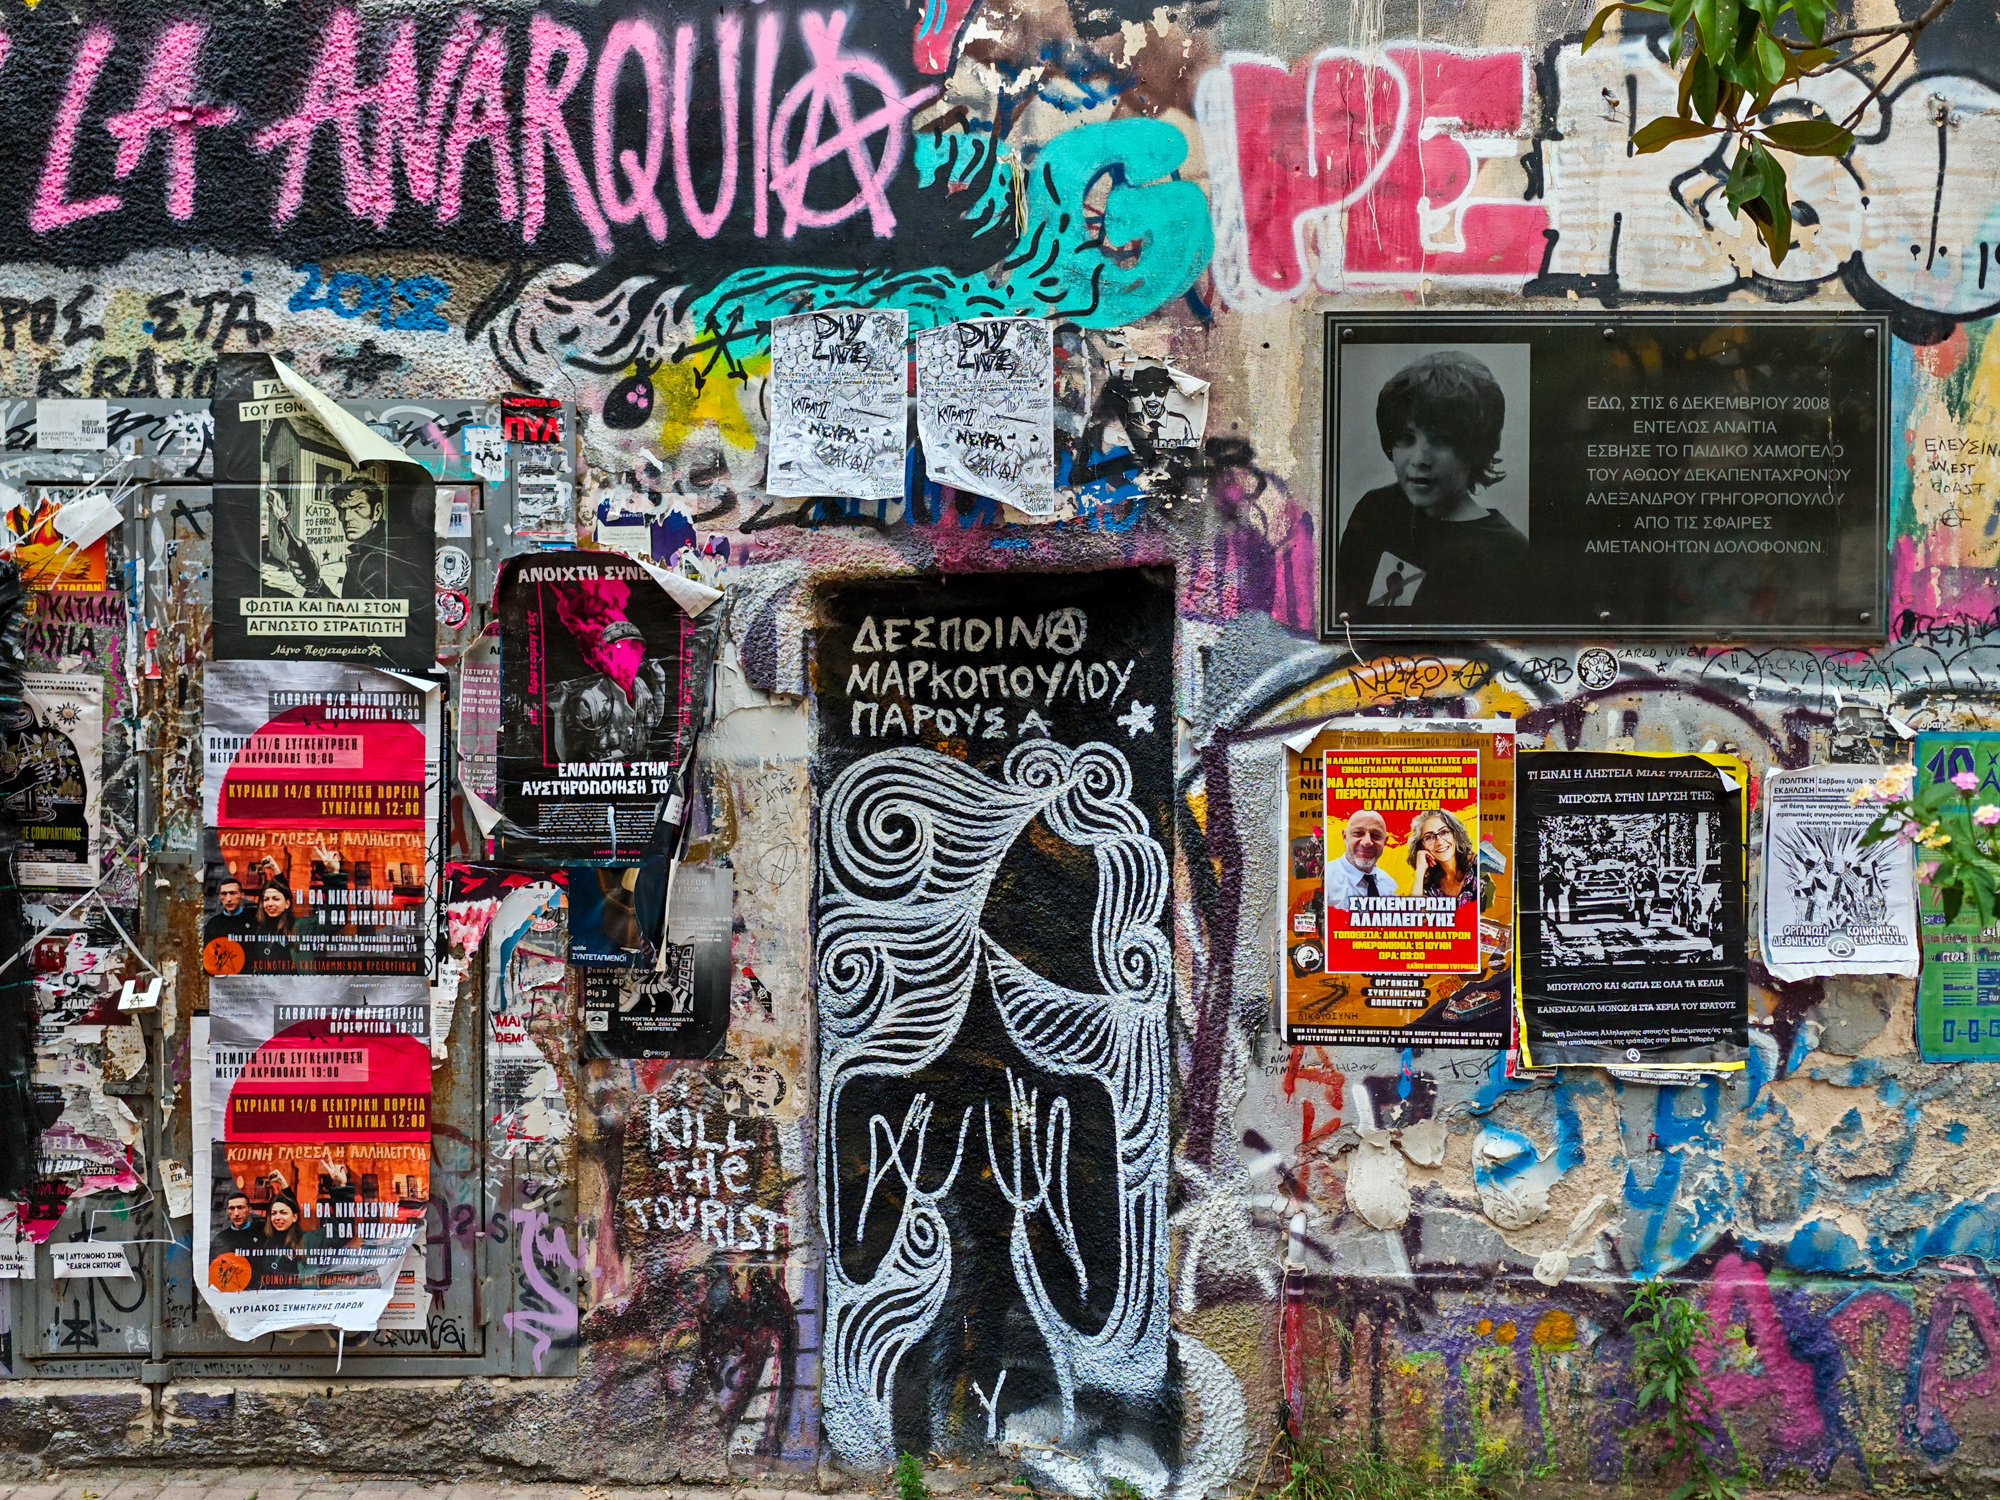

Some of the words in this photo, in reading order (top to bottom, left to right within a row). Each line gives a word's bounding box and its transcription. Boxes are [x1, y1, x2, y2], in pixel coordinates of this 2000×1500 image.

[813, 314, 866, 343] DIY
[958, 322, 1010, 349] DIY
[1588, 397, 1625, 411] ΕΔΩ,
[1631, 397, 1664, 409] ΣΤΙΣ
[1670, 397, 1678, 409] 6
[1682, 397, 1788, 409] ΔΕΚΕΜΒΡΙΟΥ
[1793, 397, 1829, 409] 2008
[242, 405, 269, 417] ΤΟΥ
[1634, 421, 1709, 433] ΕΝΤΕΛΩΣ
[1713, 421, 1777, 433] ΑΝΑΙΤΙΑ
[1588, 445, 1651, 457] ΕΣΒΗΣΕ
[1656, 445, 1677, 457] ΤΟ
[1683, 445, 1748, 457] ΠΑΙΔΙΚΟ
[1753, 445, 1843, 457] ΧΑΜΟΓΕΛΟ
[1932, 461, 1976, 475] WEST
[1587, 469, 1619, 481] ΤΟΥ
[1623, 469, 1680, 481] ΑΘΩΟΥ
[1684, 469, 1851, 481] ΔΕΚΑΠΕΝΤΑΧΡΟΝΟΥ
[1932, 482, 1985, 494] COAST
[1586, 493, 1696, 505] ΑΛΕΞΑΝΔΡΟΥ
[1701, 493, 1844, 505] ΓΡΗΓΟΡΟΠΟΥΛΟΥ
[306, 506, 330, 516] ΚΑΤΩ
[1634, 517, 1669, 529] ΑΠΟ
[1674, 517, 1698, 529] ΤΙΣ
[1704, 517, 1772, 529] ΣΦΑΙΡΕΣ
[306, 536, 344, 544] ΠΡΟΛΕΤΑΡΙΑΤΟ
[1585, 541, 1709, 553] ΑΜΕΤΑΝΟΗΤΩΝ
[1714, 541, 1825, 553] ΔΟΛΟΦΟΝΩΝ.
[518, 565, 598, 583] ΑΝΟΙΧΤΗ
[246, 600, 293, 613] ΦΩΤΙΑ
[300, 601, 322, 612] ΚΑΙ
[327, 602, 358, 613] ΠΑΛΙ
[364, 603, 400, 613] ΣΤΟΝ
[250, 621, 317, 631] ΑΓΝΩΣΤΟ
[324, 621, 402, 632] ΣΤΡΑΤΙΩΤΗ
[852, 607, 1087, 655] ΔΕΣΠΟΙΝΑ
[1617, 648, 1656, 658] CARLO
[846, 660, 1135, 708] ΜΑΡΚΟΠΟΥΛΟΥ
[274, 693, 321, 706] ΣΑΒΒΑΤΟ
[327, 694, 345, 706] 6/6
[351, 694, 419, 706] ΜΟΤΟΠΟΡΕΙΑ
[326, 708, 386, 720] ΠΡΟΣΦΥΓΙΚΑ
[392, 709, 419, 720] 19:30
[210, 738, 251, 750] ΠΕΜΠΤΗ
[257, 738, 280, 750] 11/6
[286, 738, 357, 750] ΣΥΓΚΕΝΤΡΩΣΗ
[210, 753, 239, 763] ΜΕΤΡΟ
[245, 753, 301, 763] ΑΚΡΟΠΟΛΗΣ
[306, 753, 334, 764] 19:00
[558, 762, 625, 777] ΕΝΑΝΤΙΑ
[630, 762, 668, 776] ΣΤΗΝ
[1528, 771, 1538, 779] ΤΙ
[1540, 770, 1571, 779] ΕΙΝΑΙ
[1574, 770, 1582, 778] Η
[1585, 769, 1633, 778] ΛΗΣΤΕΙΑ
[522, 780, 646, 796] ΑΥΣΤΗΡΟΠΟΙΗΣΗ
[1327, 778, 1344, 788] ΝΑ
[1346, 778, 1403, 788] ΑΦΕΘΟΥΝ
[1405, 778, 1467, 788] ΕΛΕΥΘΕΡΟΙ
[1469, 778, 1477, 788] Η
[229, 785, 278, 798] ΚΥΡΙΑΚΗ
[284, 785, 310, 798] 14/6
[317, 785, 372, 798] ΚΕΝΤΡΙΚΗ
[378, 786, 419, 799] ΠΟΡΕΙΑ
[1335, 789, 1387, 799] ΠΕΡΙΧΑΝ
[1388, 789, 1446, 799] ΑΤΜΑΤΖΑ
[1448, 789, 1468, 799] ΚΑΙ
[1559, 794, 1612, 803] ΜΠΡΟΣΤΑ
[1615, 793, 1645, 802] ΣΤΗΝ
[1647, 792, 1688, 801] ΙΔΡΥΣΗ
[1690, 791, 1714, 800] ΤΗΣ;
[322, 802, 380, 815] ΣΥΝΤΑΓΜΑ
[386, 802, 419, 815] 12:00
[1364, 800, 1372, 810] Ο
[1374, 800, 1394, 810] ΑΛΙ
[1396, 800, 1440, 810] ΑΙΤΖΕΝ!
[31, 827, 82, 841] COMPARTIMOS
[220, 833, 266, 847] ΚΟΙΝΗ
[344, 833, 422, 848] ΑΛΛΗΛΕΓΓΥΗ
[309, 890, 323, 905] ΘΑ
[329, 890, 393, 905] ΝΙΚΗΣΟΥΜΕ
[1350, 897, 1456, 911] ΣΥΓΚΕΝΤΡΩΣΗ
[331, 911, 346, 925] ΘΑ
[351, 911, 416, 926] ΝΙΚΗΣΟΥΜΕ
[1350, 913, 1455, 927] ΑΛΛΗΛΕΓΓΥΗΣ
[1333, 931, 1382, 939] ΤΟΠΟΘΕΣΙΑ:
[1784, 925, 1830, 936] ΟΡΓΑΝΩΣΗ
[1846, 925, 1898, 936] ΚΟΙΝΩΝΙΚΗ
[1772, 936, 1826, 946] ΔΙΕΘΝΙΣΜΟΣ
[1854, 935, 1908, 945] ΕΠΑΝΑΣΤΑΣΗ
[572, 954, 626, 962] ΣΥΝΤΕΤΑΓΜΕΝΟΙ
[1547, 982, 1602, 991] ΜΠΟΥΡΛΟΤΟ
[1604, 982, 1619, 990] ΚΑΙ
[1621, 981, 1649, 990] ΦΩΤΙΑ
[1698, 980, 1724, 988] ΚΕΛΙΑ
[1538, 1005, 1595, 1014] ΚΑΝΕΝΑΣ/ΜΙΑ
[1598, 1004, 1637, 1012] ΜΟΝΟΣ/Η
[1656, 1003, 1680, 1011] ΧΕΡΙΑ
[650, 1098, 756, 1151] KILL
[625, 1196, 792, 1250] TOURIST
[230, 1304, 280, 1315] ΚΥΡΙΑΚΟΣ
[283, 1303, 332, 1312] ΞΥΜΗΤΗΡΗΣ
[334, 1301, 364, 1310] ΠΑΡΩΝ
